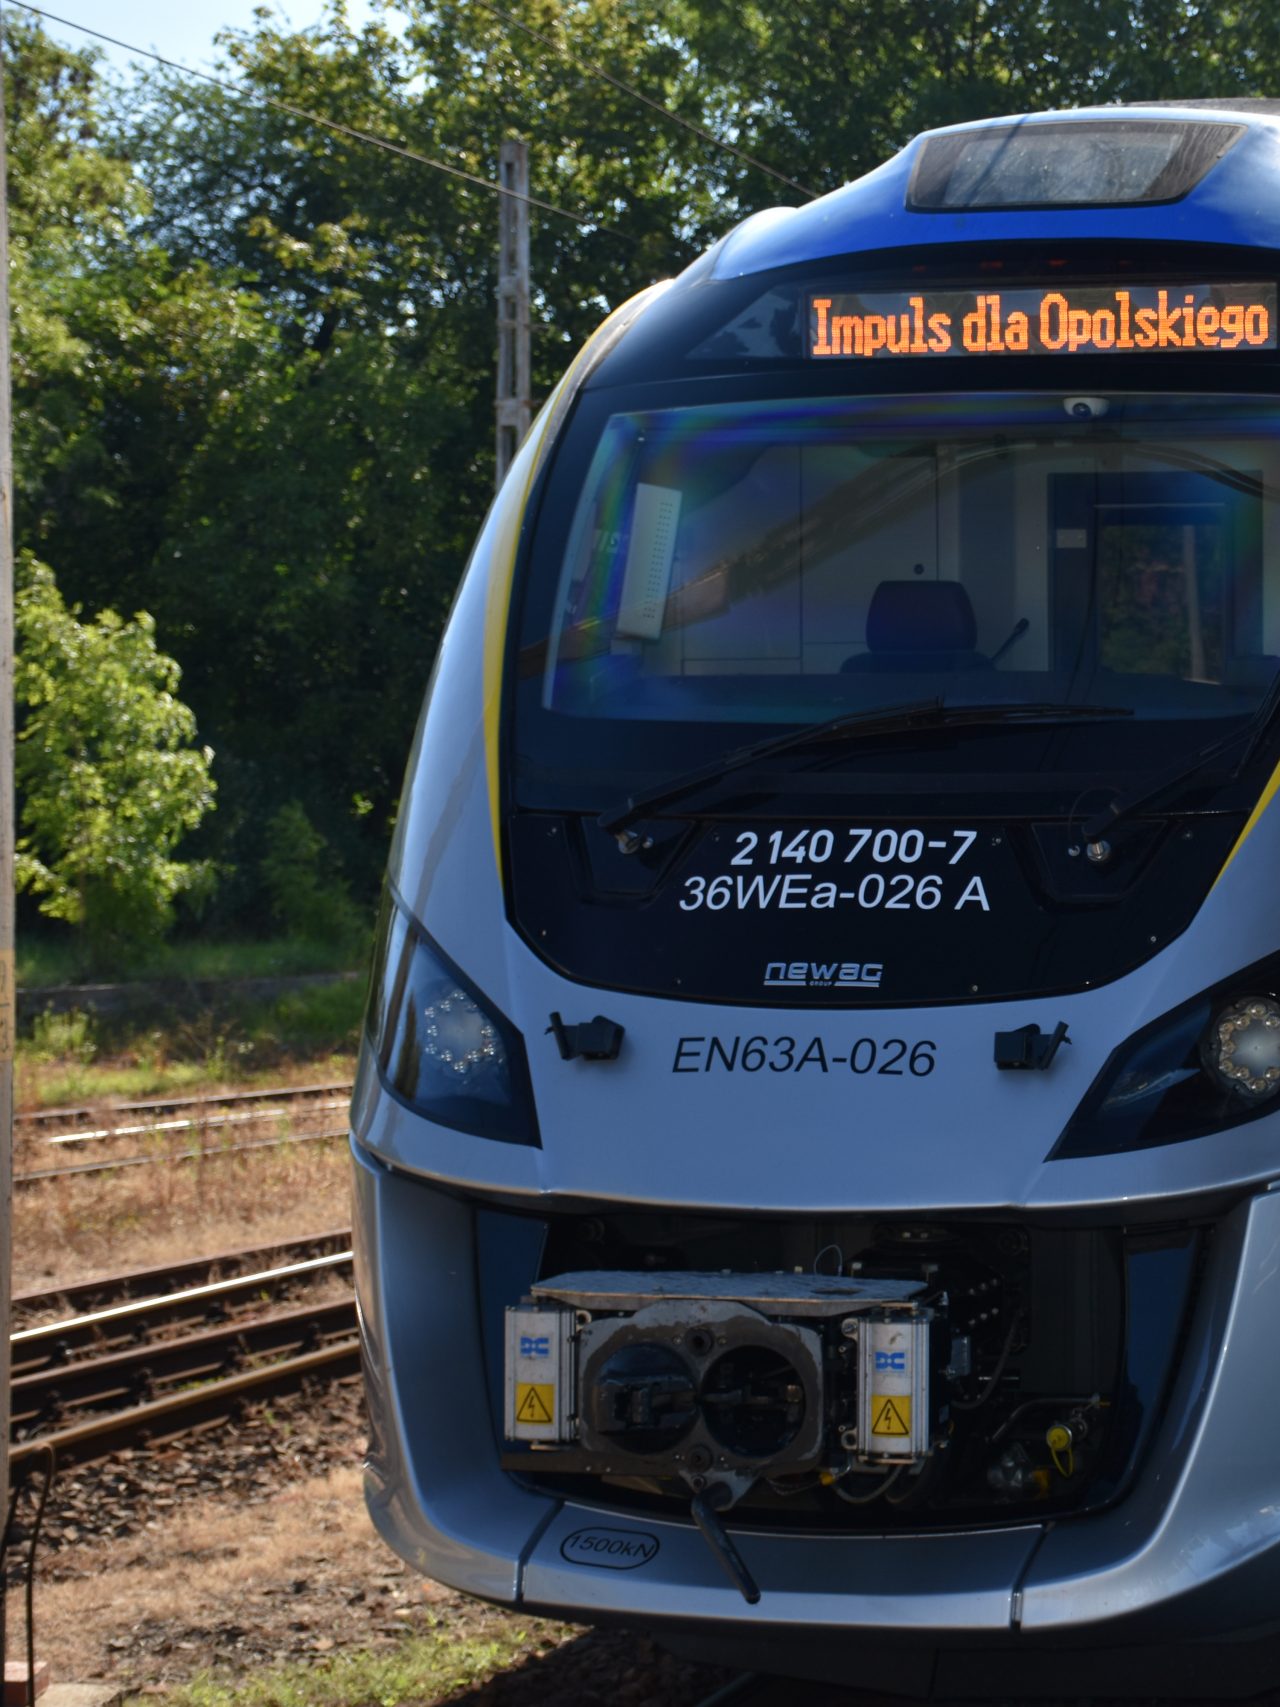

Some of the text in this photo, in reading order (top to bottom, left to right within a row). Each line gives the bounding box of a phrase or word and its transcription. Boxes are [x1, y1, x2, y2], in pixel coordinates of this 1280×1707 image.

[813, 291, 1269, 357] Impuls dla Opolskiego
[731, 829, 977, 865] 2 140 700-7
[679, 874, 990, 911] 36WEa-026 A
[672, 1036, 937, 1077] EN63A-026
[568, 1534, 655, 1559] 1500kN
